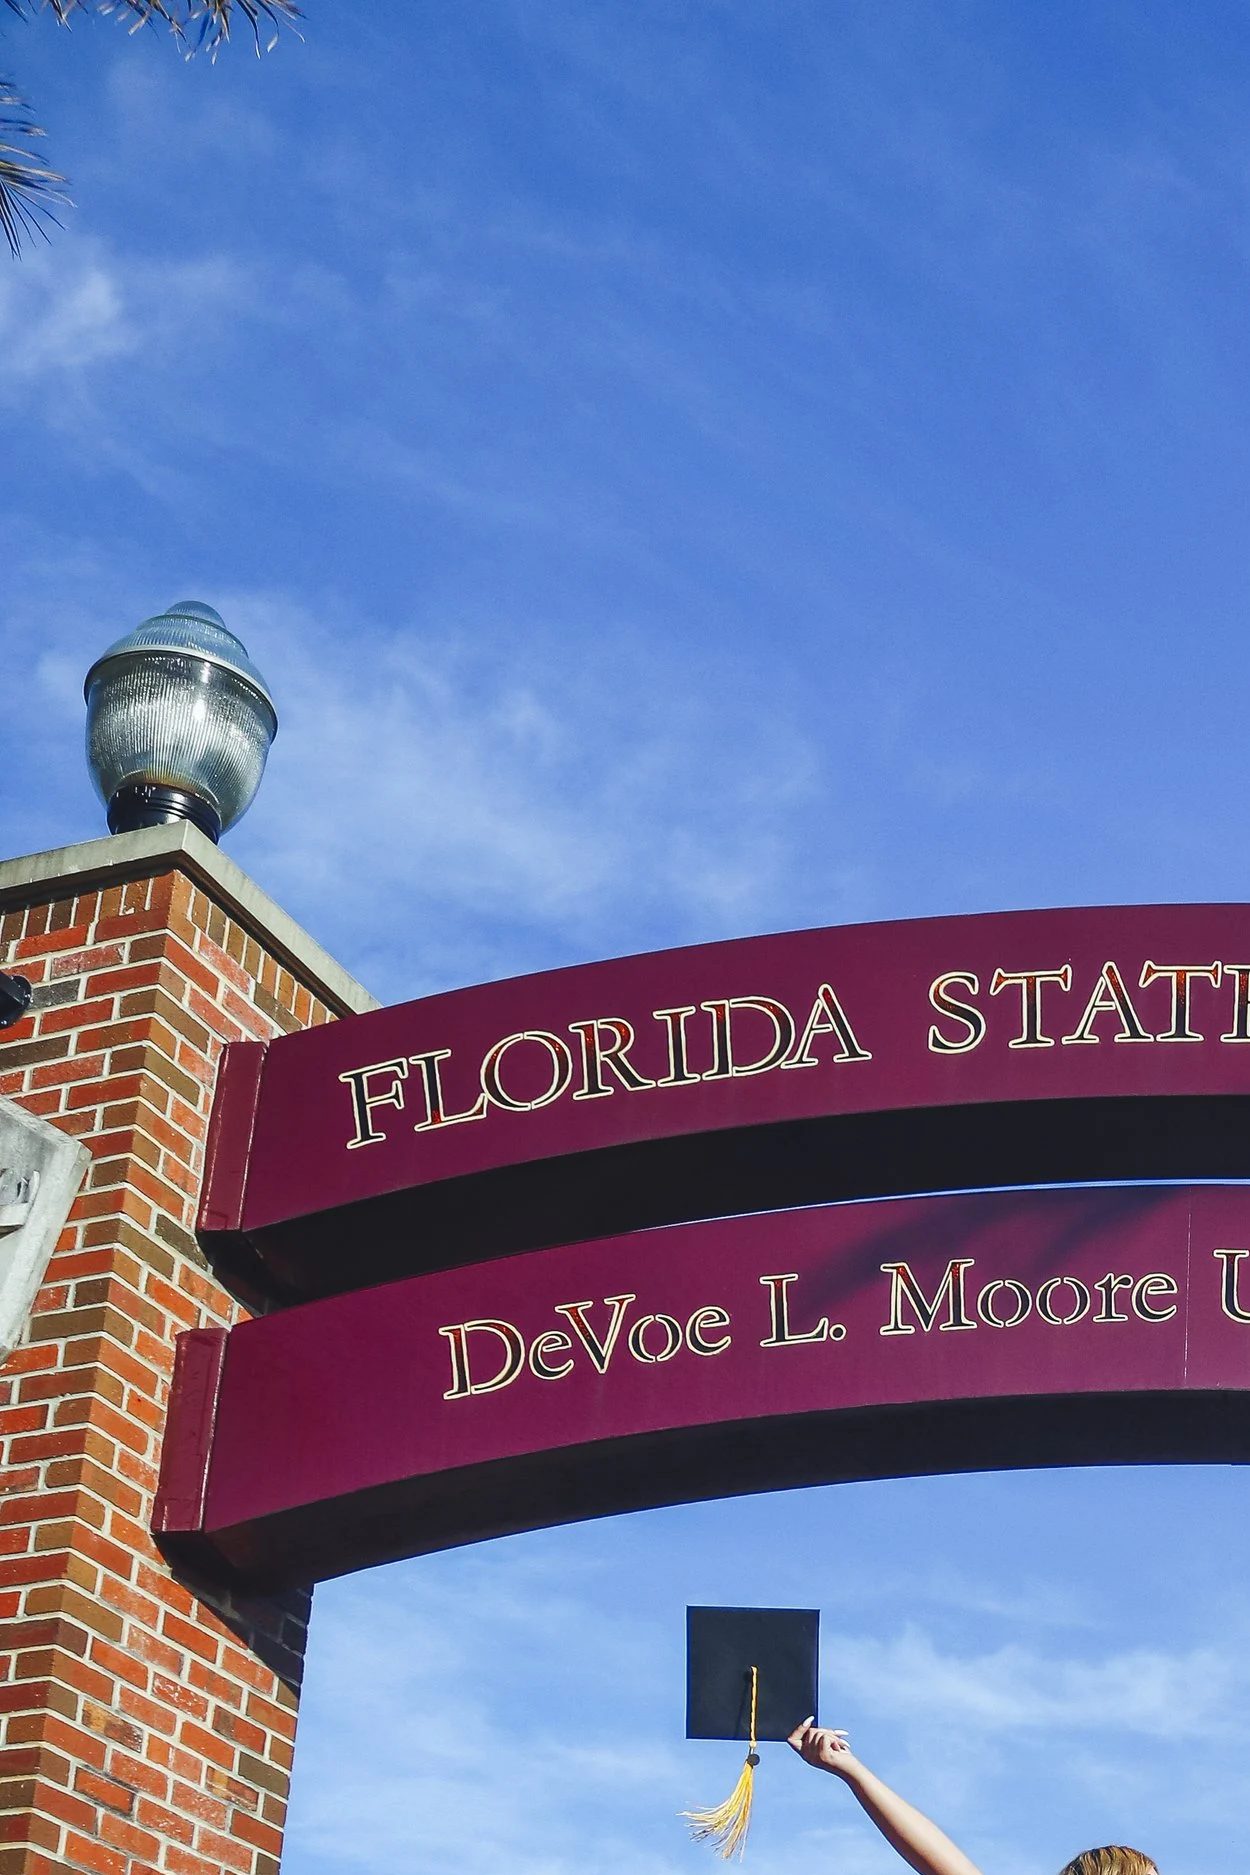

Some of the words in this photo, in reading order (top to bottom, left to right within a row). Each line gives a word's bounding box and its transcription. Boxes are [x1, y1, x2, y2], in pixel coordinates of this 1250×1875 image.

[339, 984, 871, 1150] FLORIDA
[444, 1294, 732, 1401] DeVoe
[760, 1272, 847, 1349] L.
[880, 1258, 1178, 1338] Moore
